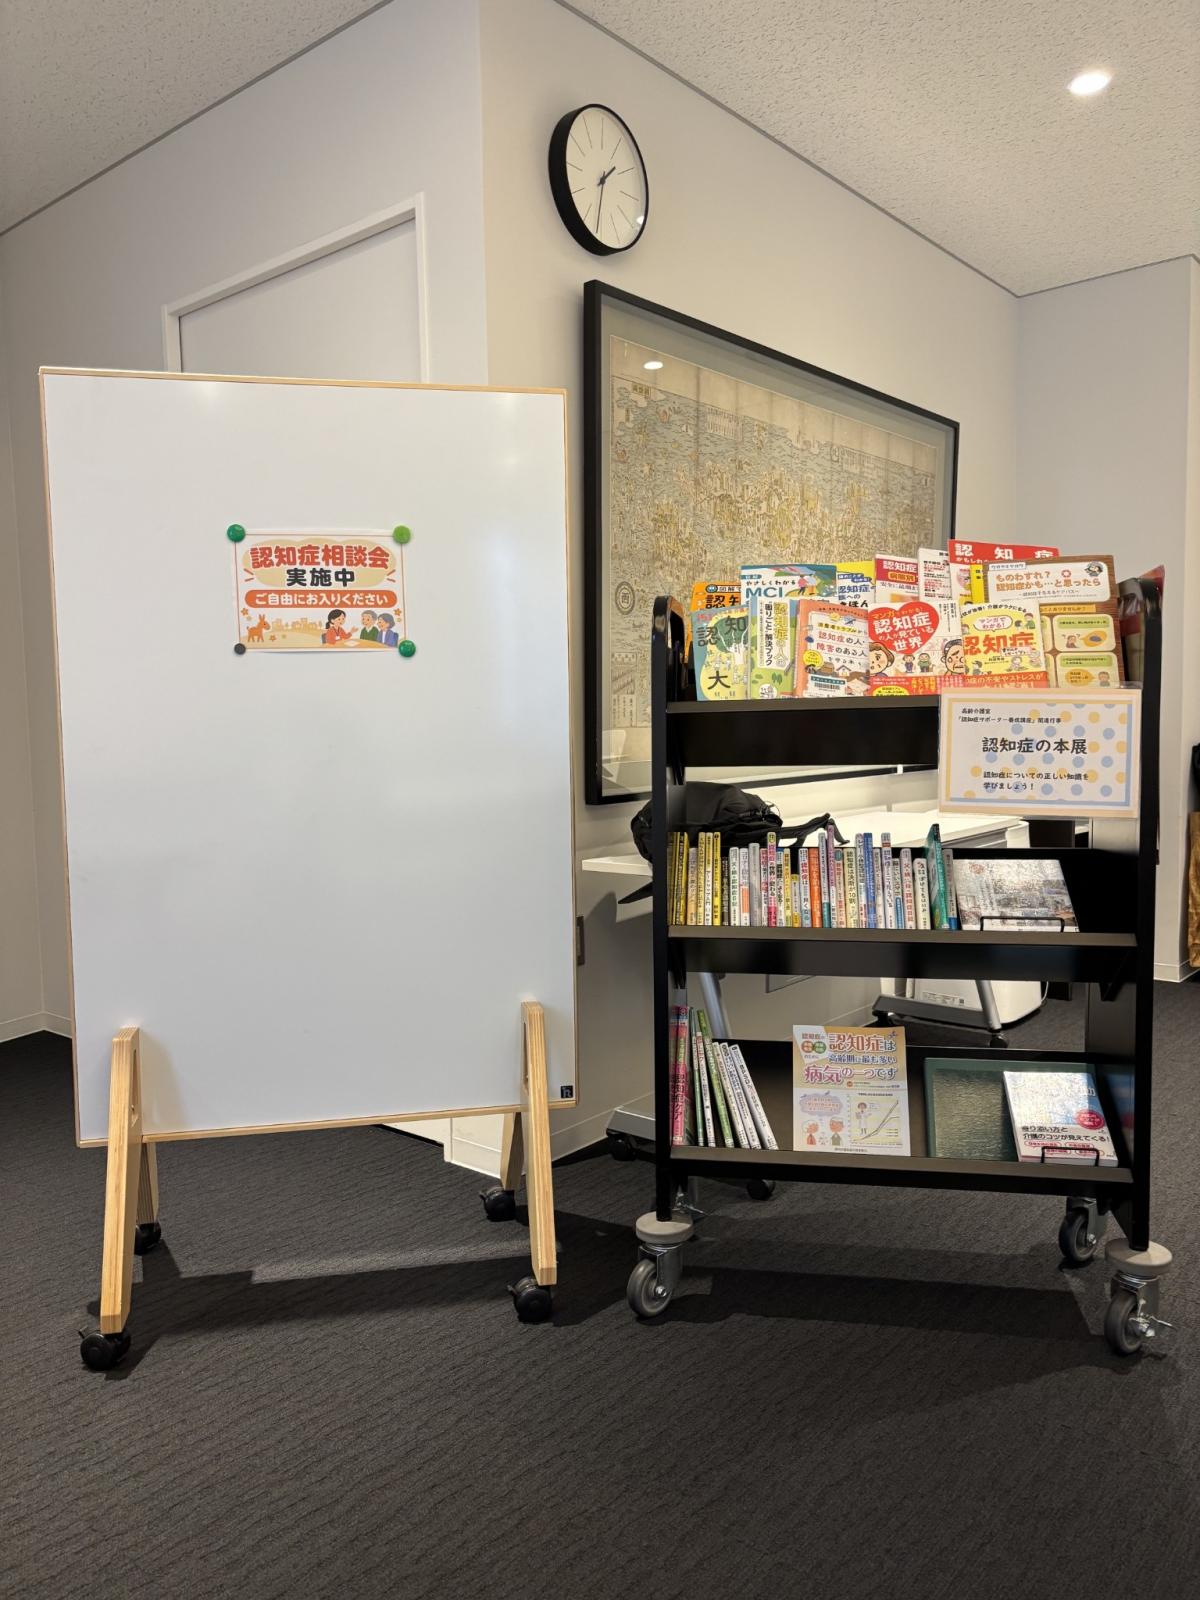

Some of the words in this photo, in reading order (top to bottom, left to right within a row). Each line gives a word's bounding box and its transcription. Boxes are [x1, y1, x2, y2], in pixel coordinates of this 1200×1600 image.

[250, 544, 390, 569] 認知症相談会
[286, 568, 355, 587] 実施中
[255, 592, 388, 606] ご自由にお入りください
[745, 587, 784, 599] MCI
[873, 611, 932, 634] 認知症
[816, 642, 868, 658] 障害のある人
[892, 636, 924, 652] 世界
[981, 736, 1088, 755] 認知症の本展
[983, 770, 1089, 781] 認知症についての正しい知識を
[983, 781, 1034, 791] 学びましょう！
[828, 1033, 897, 1052] 認知症は
[828, 1053, 898, 1065] 高齢期に最も多い
[804, 1064, 898, 1084] 病気の一つです
